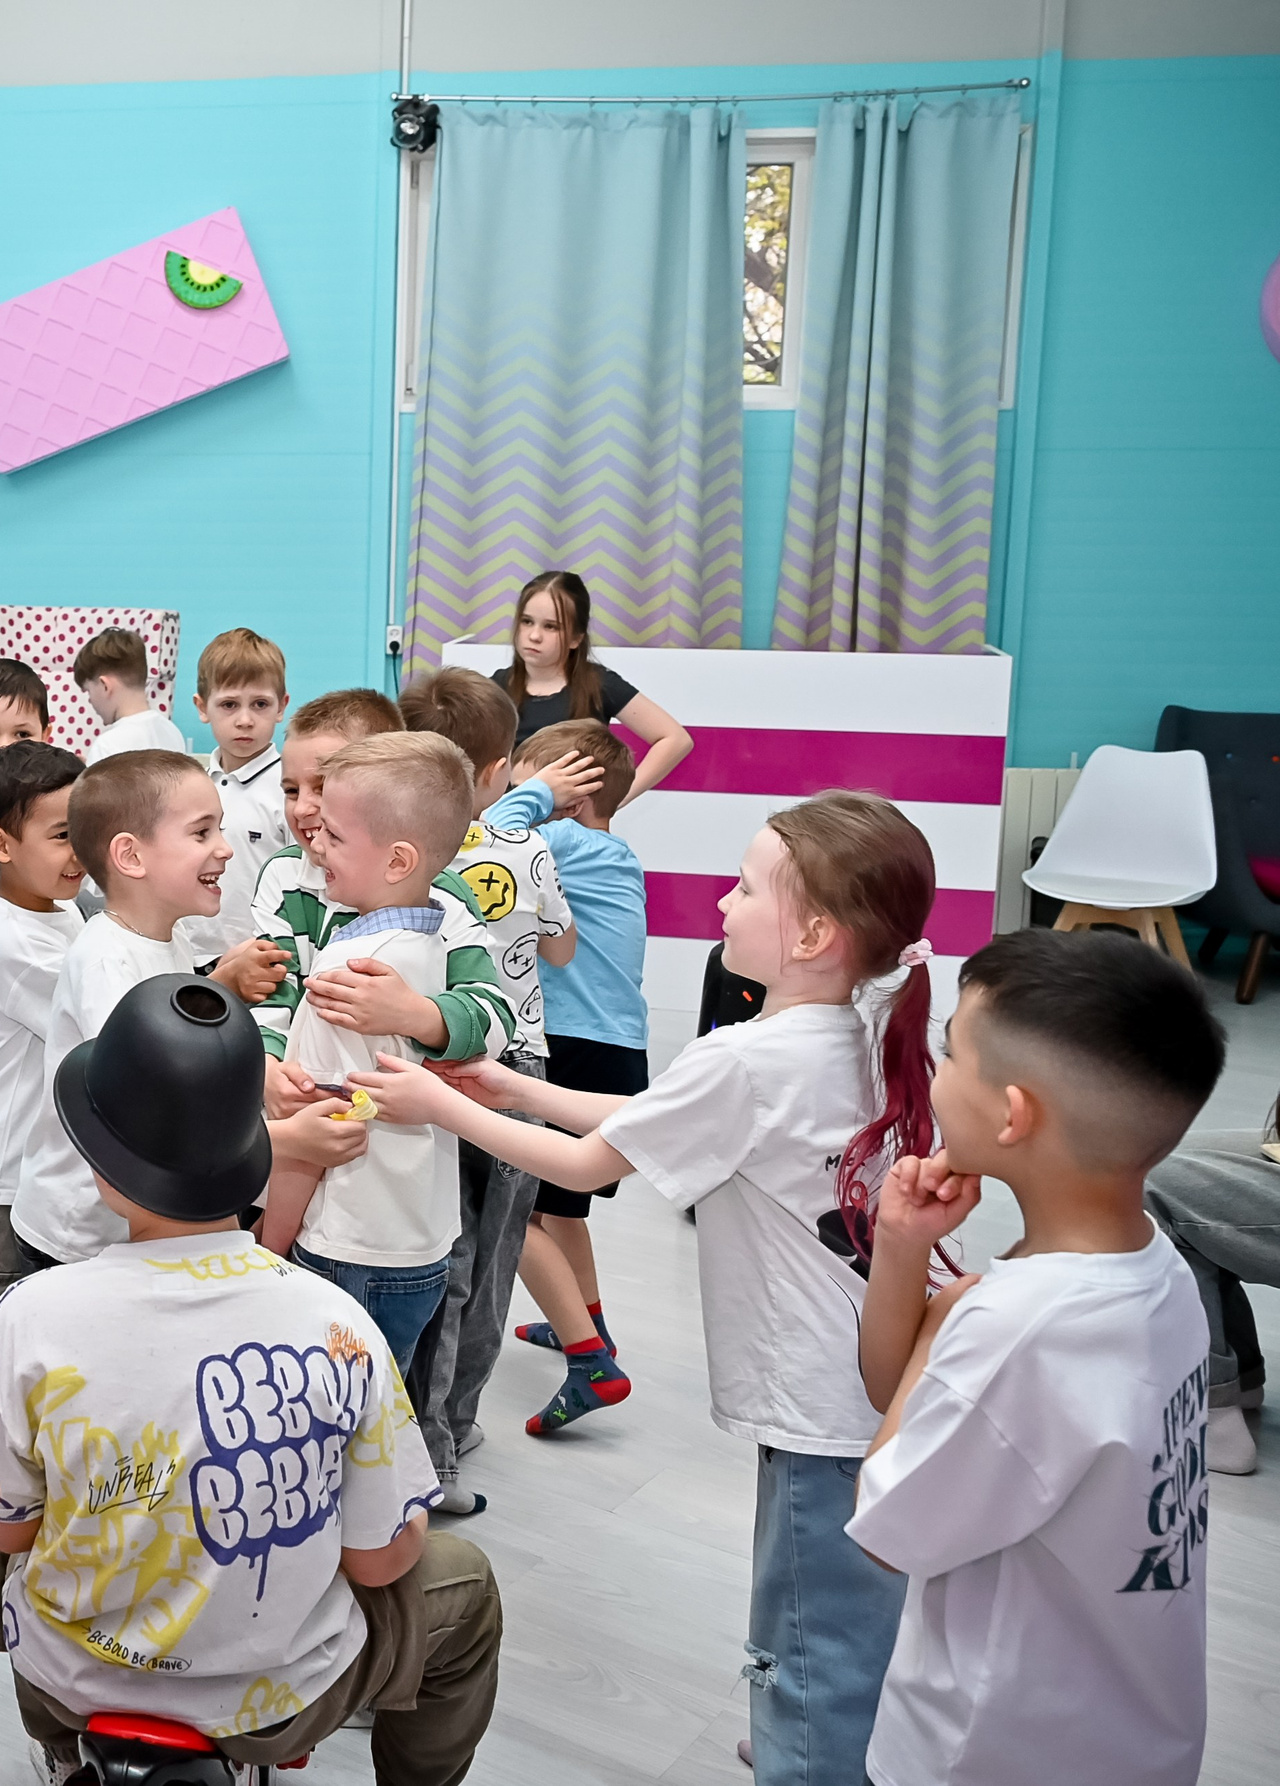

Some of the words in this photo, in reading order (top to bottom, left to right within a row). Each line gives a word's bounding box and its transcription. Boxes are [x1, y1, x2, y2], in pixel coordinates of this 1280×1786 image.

[86, 1630, 106, 1646] BE
[102, 1636, 129, 1660] BOLD
[131, 1651, 146, 1667] BE
[151, 1657, 183, 1671] BRAVE
